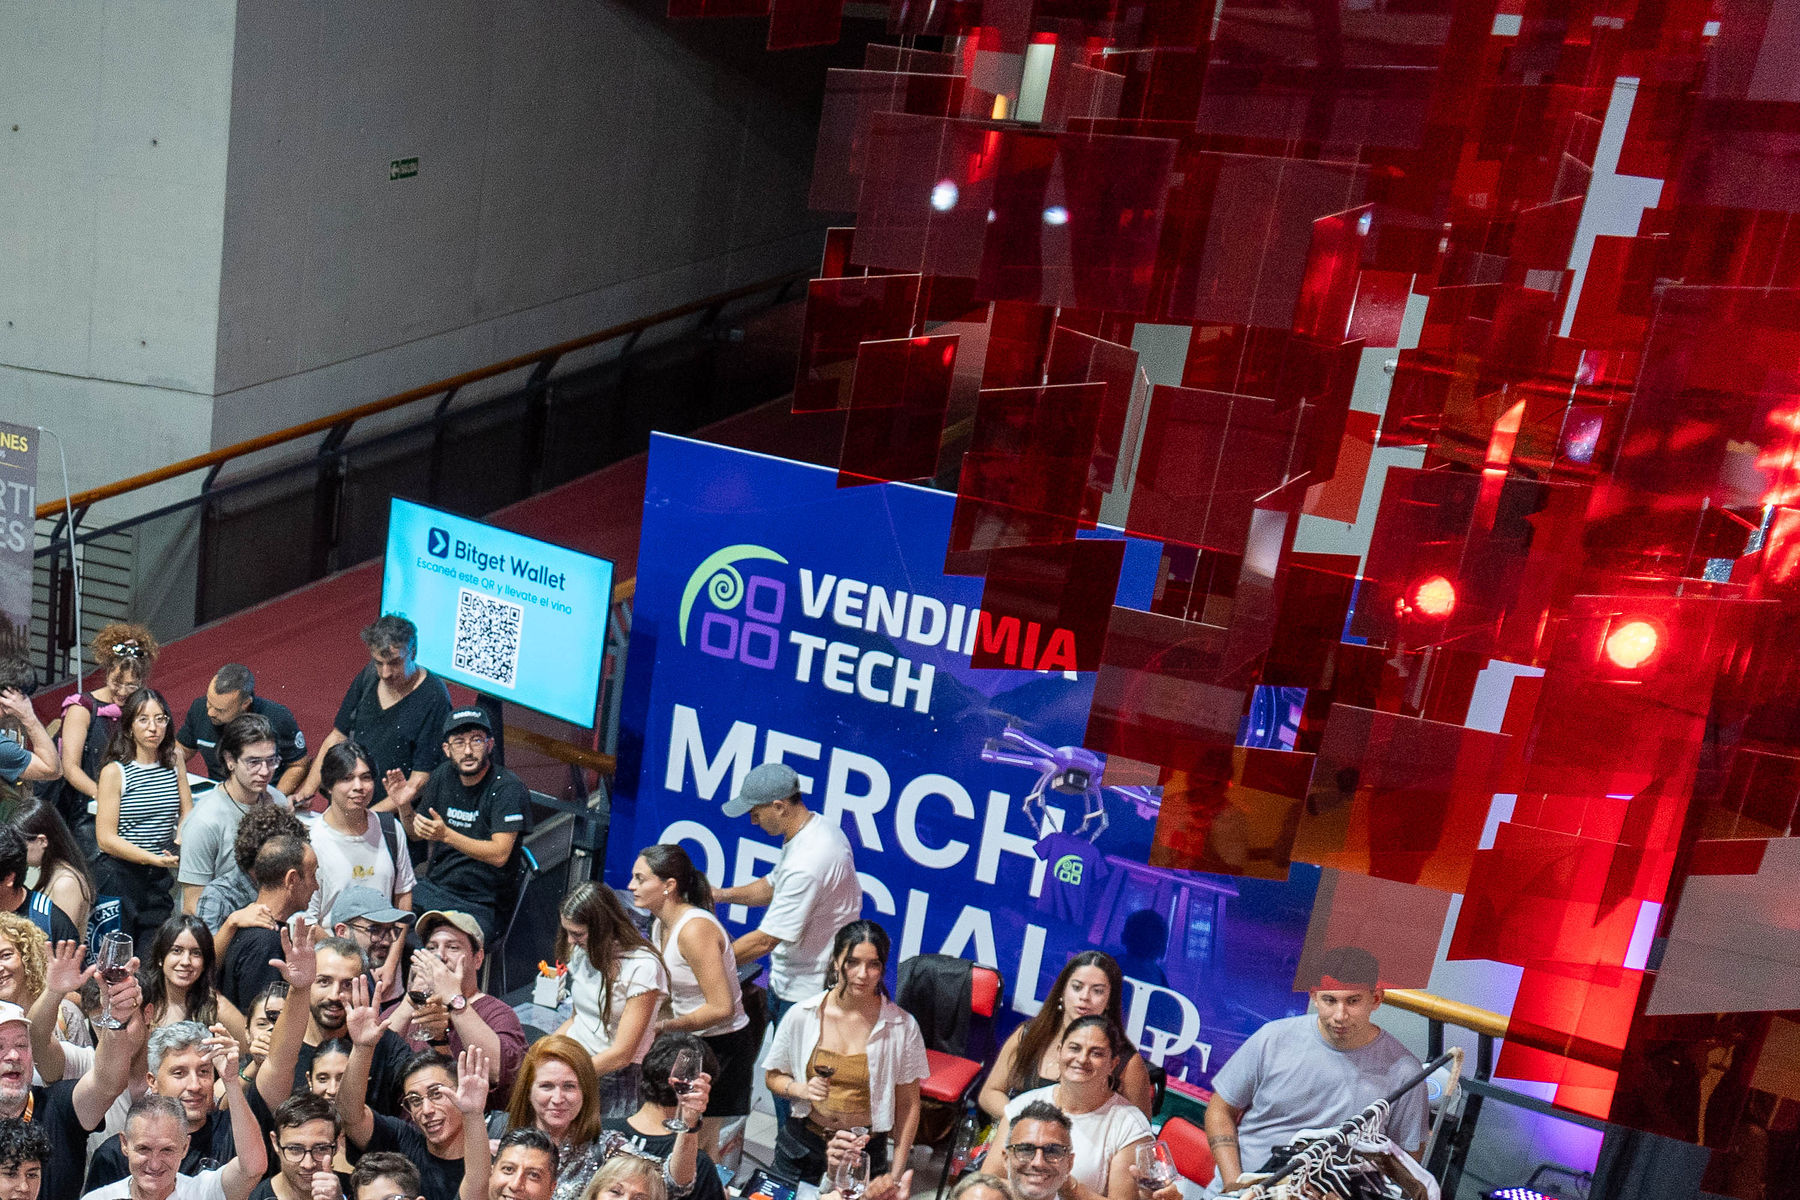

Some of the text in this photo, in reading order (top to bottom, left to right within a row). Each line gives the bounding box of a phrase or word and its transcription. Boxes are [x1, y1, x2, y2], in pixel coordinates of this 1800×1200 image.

[454, 540, 567, 591] Bitget Wallet
[458, 571, 480, 586] este
[481, 577, 495, 591] QR
[497, 583, 503, 595] y
[505, 584, 538, 604] llevate
[540, 595, 549, 608] el
[550, 601, 572, 615] vino
[799, 567, 1080, 681] VENDIMIA
[788, 630, 937, 715] TECH
[664, 703, 1067, 899] MERCH
